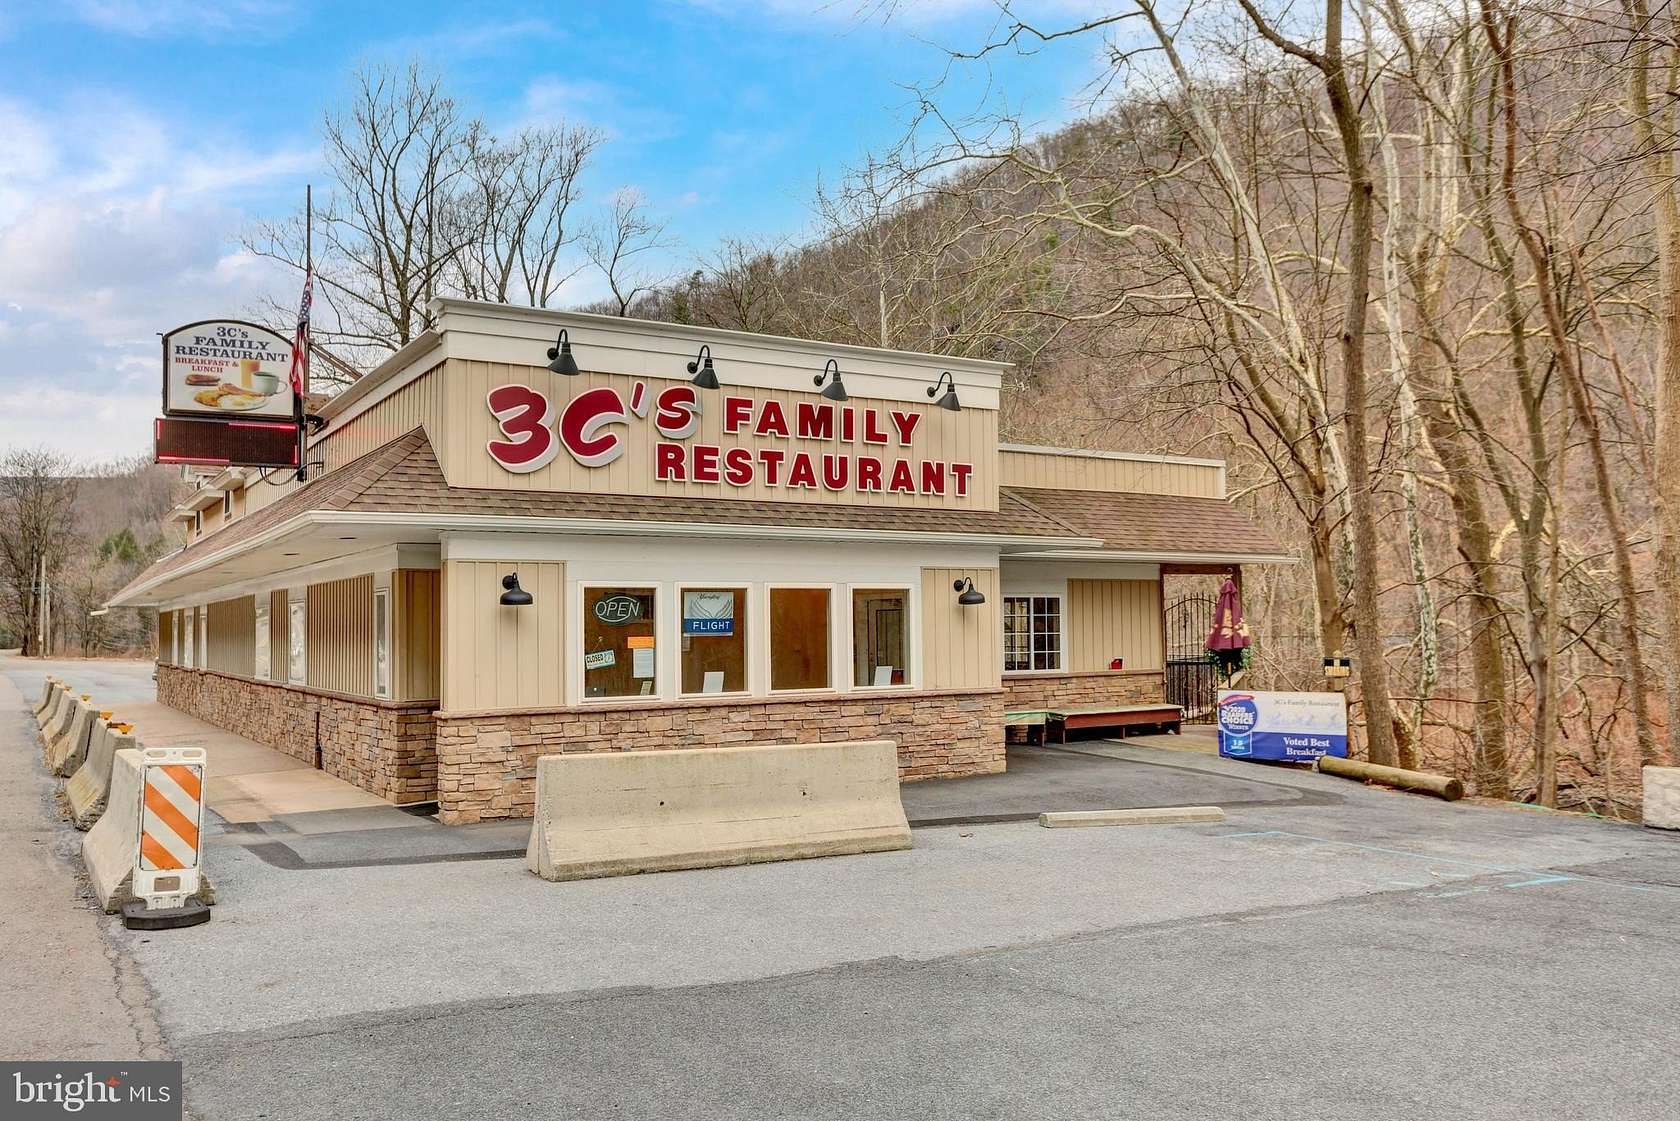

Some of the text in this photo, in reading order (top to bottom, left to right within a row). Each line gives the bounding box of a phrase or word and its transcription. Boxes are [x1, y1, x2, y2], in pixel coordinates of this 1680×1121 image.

[216, 326, 249, 339] 3C's
[193, 335, 271, 351] FAMILY
[174, 345, 289, 362] RESTAURANT
[175, 357, 231, 368] BREAKFAST
[722, 395, 922, 447] FAMILY
[654, 441, 974, 498] RESTAURANT
[595, 601, 640, 617] OPEN
[692, 621, 731, 630] FLIGHT
[586, 653, 604, 664] CLOSED
[1221, 716, 1254, 725] CHOICE
[1283, 736, 1331, 748] Voted Best
[1286, 747, 1328, 757] Breakfast
